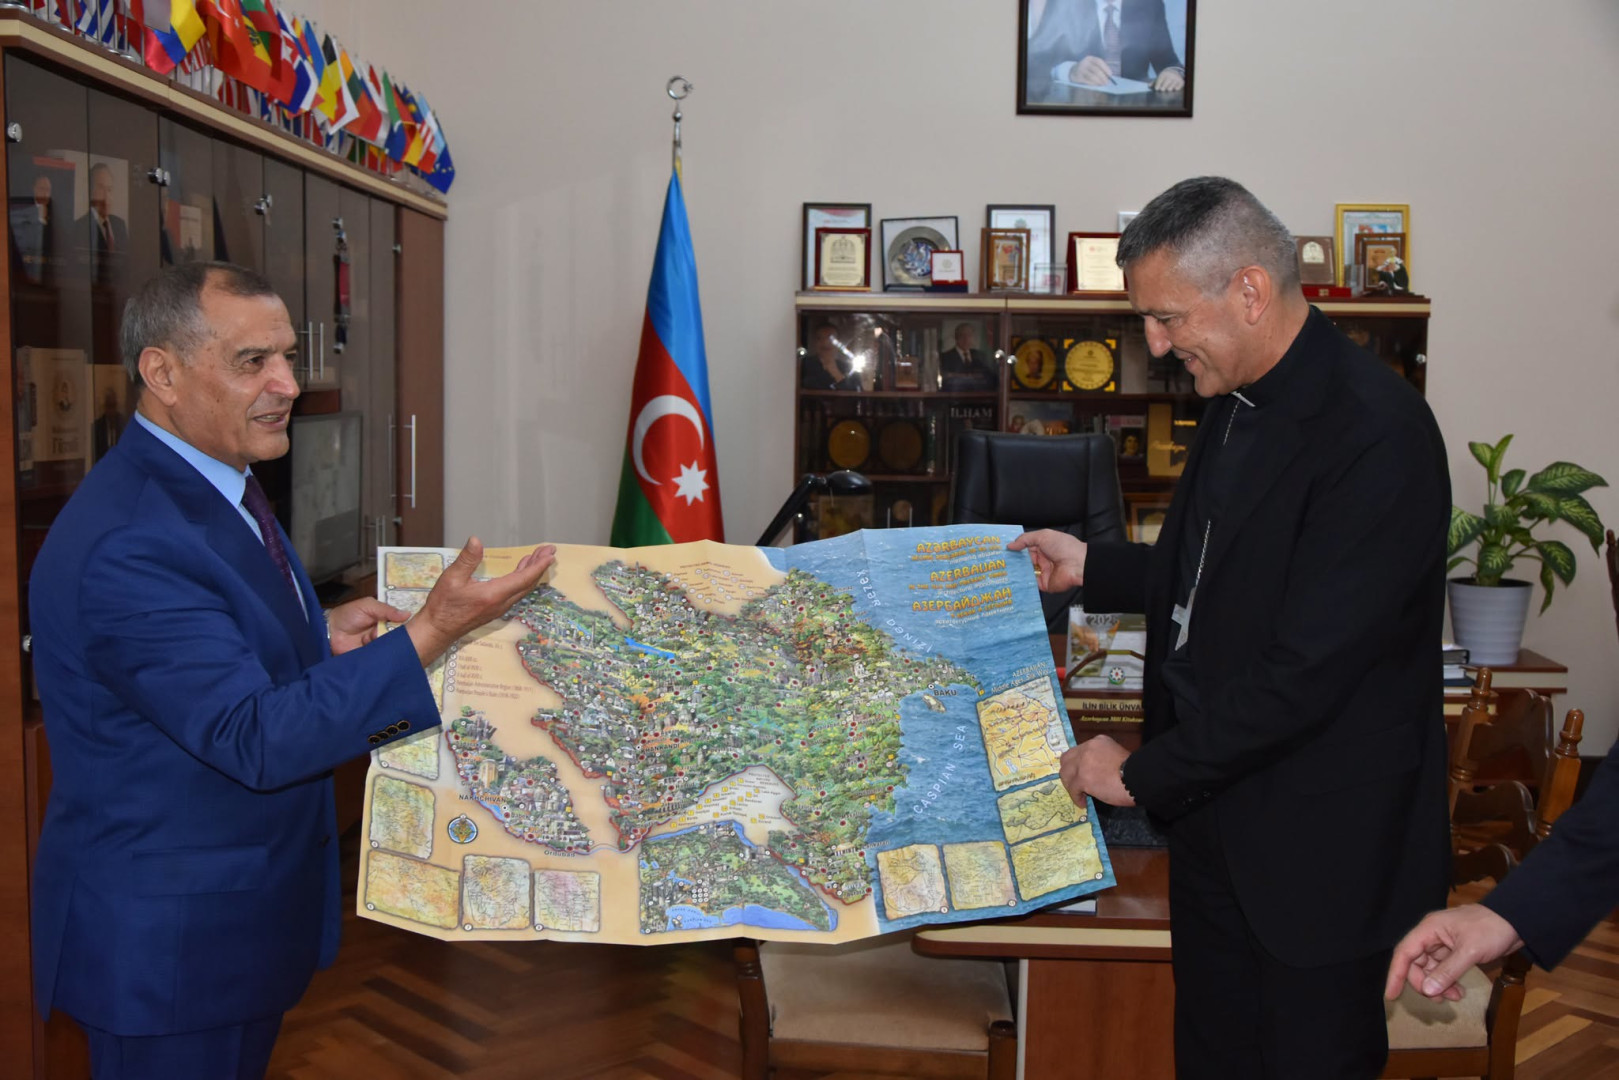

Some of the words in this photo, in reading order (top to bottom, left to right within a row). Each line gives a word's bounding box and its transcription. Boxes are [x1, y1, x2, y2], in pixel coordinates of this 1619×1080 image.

[916, 536, 1000, 553] AZƏRBAYCAN
[930, 559, 1006, 582] AZERBAIJAN
[912, 587, 1012, 612] АЗЕРБАЙДЖАН
[913, 762, 956, 814] CASPIAN
[953, 725, 966, 750] SEA
